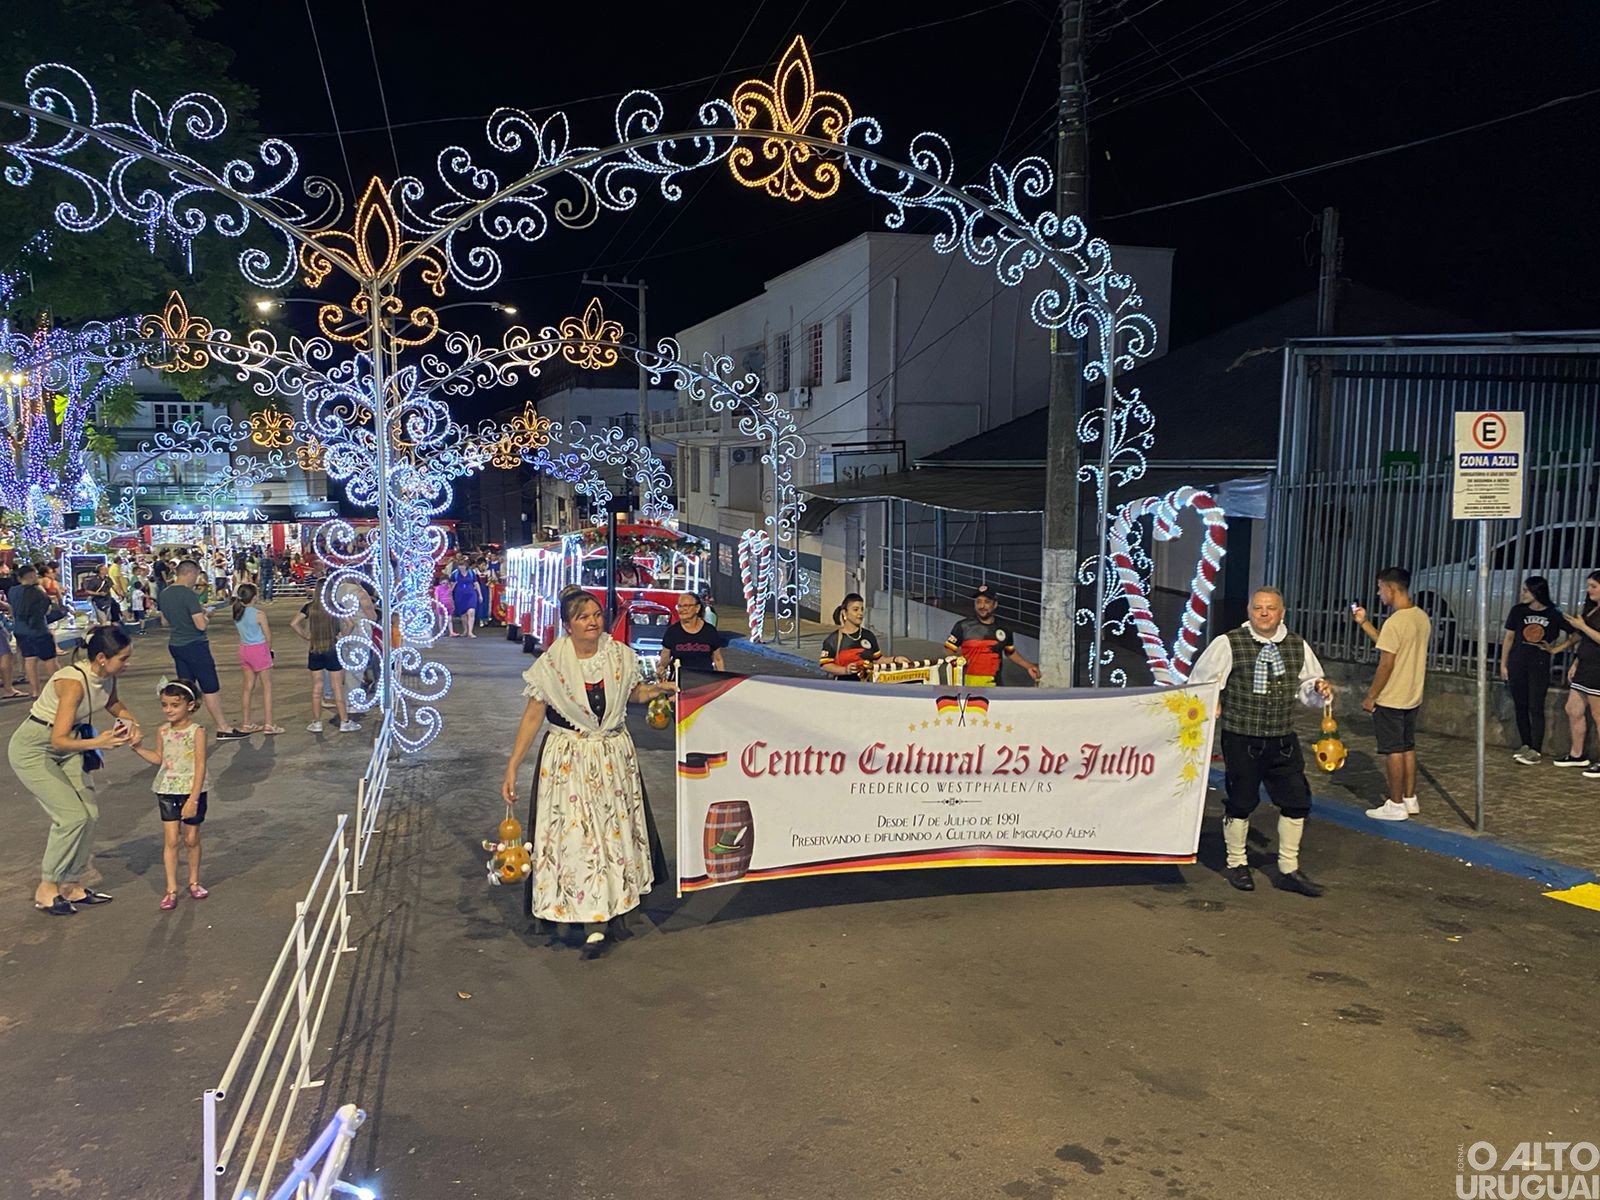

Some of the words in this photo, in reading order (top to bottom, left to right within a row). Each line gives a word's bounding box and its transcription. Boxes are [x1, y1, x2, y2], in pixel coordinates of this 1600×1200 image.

[1483, 422, 1497, 442] E
[1461, 456, 1490, 467] ZONA
[1492, 456, 1518, 467] AZUL
[740, 741, 846, 778] Centro
[858, 741, 985, 776] Cultural
[992, 744, 1031, 776] 25
[1037, 744, 1070, 776] de
[1073, 742, 1156, 782] Julho
[850, 781, 930, 795] FREDERICO
[936, 780, 1053, 793] WESTPHALEN/RS
[913, 813, 926, 827] 17
[996, 813, 1020, 826] 1991
